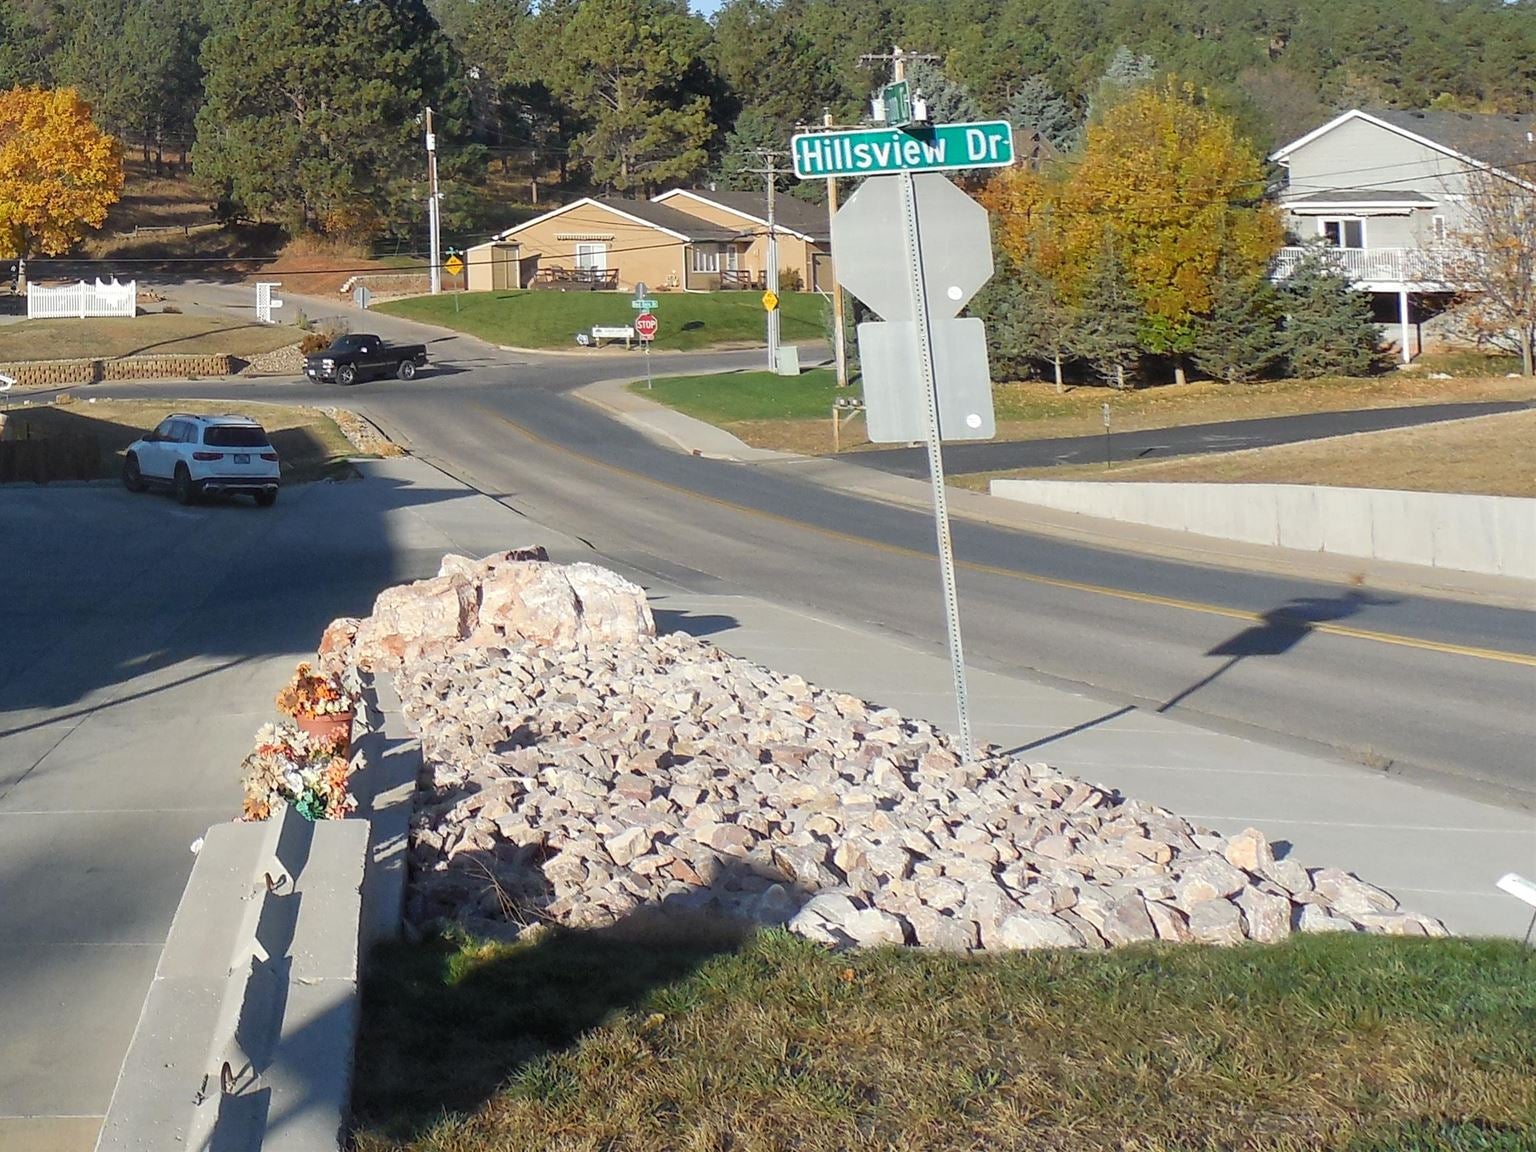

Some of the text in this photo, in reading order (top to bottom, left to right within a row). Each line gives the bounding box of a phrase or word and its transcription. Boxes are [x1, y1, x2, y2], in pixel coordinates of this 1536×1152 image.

[801, 128, 1003, 173] Hillsview Dr
[637, 320, 656, 329] STOP
